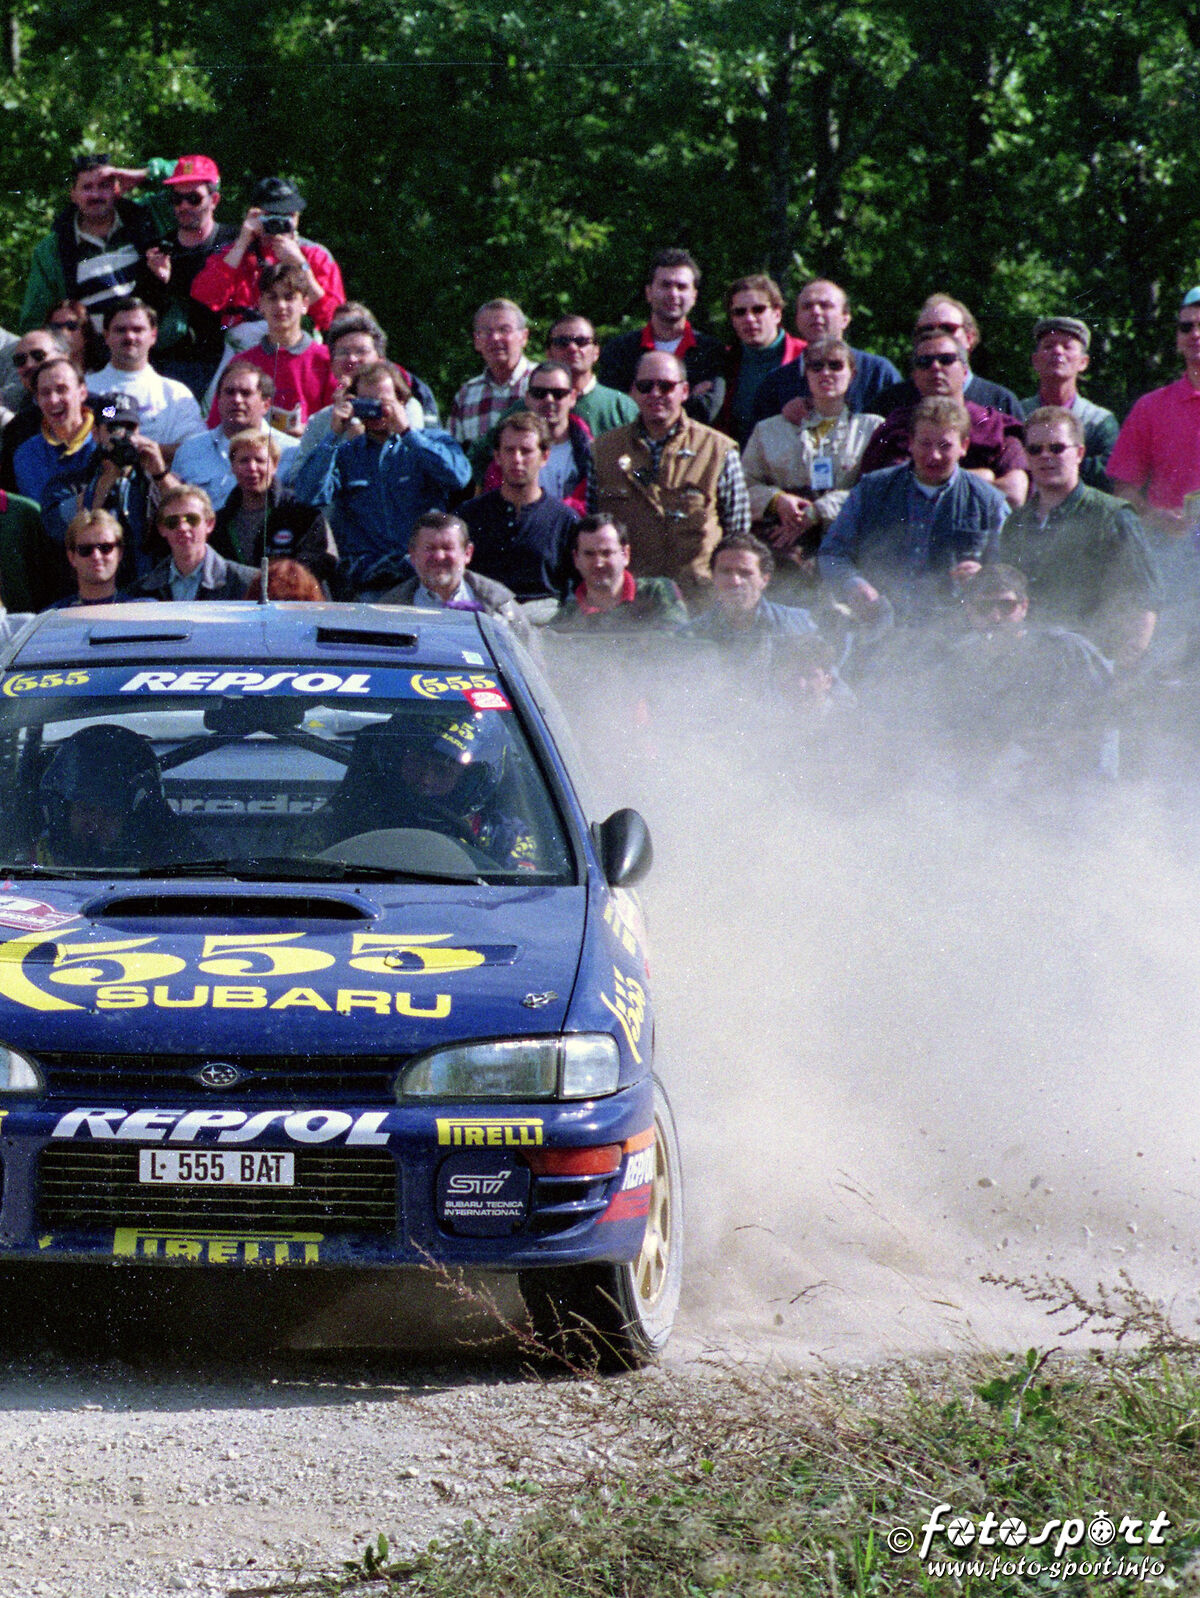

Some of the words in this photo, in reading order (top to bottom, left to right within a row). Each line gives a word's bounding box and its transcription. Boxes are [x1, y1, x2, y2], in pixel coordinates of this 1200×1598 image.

[13, 671, 90, 691] 555
[119, 671, 372, 694] REPSOL
[421, 675, 497, 694] 555
[49, 931, 486, 986] 555
[96, 985, 452, 1018] SUBARU
[51, 1106, 392, 1146] REPSOL
[435, 1118, 544, 1146] PIRELLI
[150, 1152, 164, 1181] L
[178, 1153, 225, 1182] 555
[240, 1154, 285, 1184] BAT
[444, 1208, 521, 1217] INTERNATIONAL
[445, 1201, 484, 1209] SUBARU
[486, 1201, 524, 1209] TECNICA
